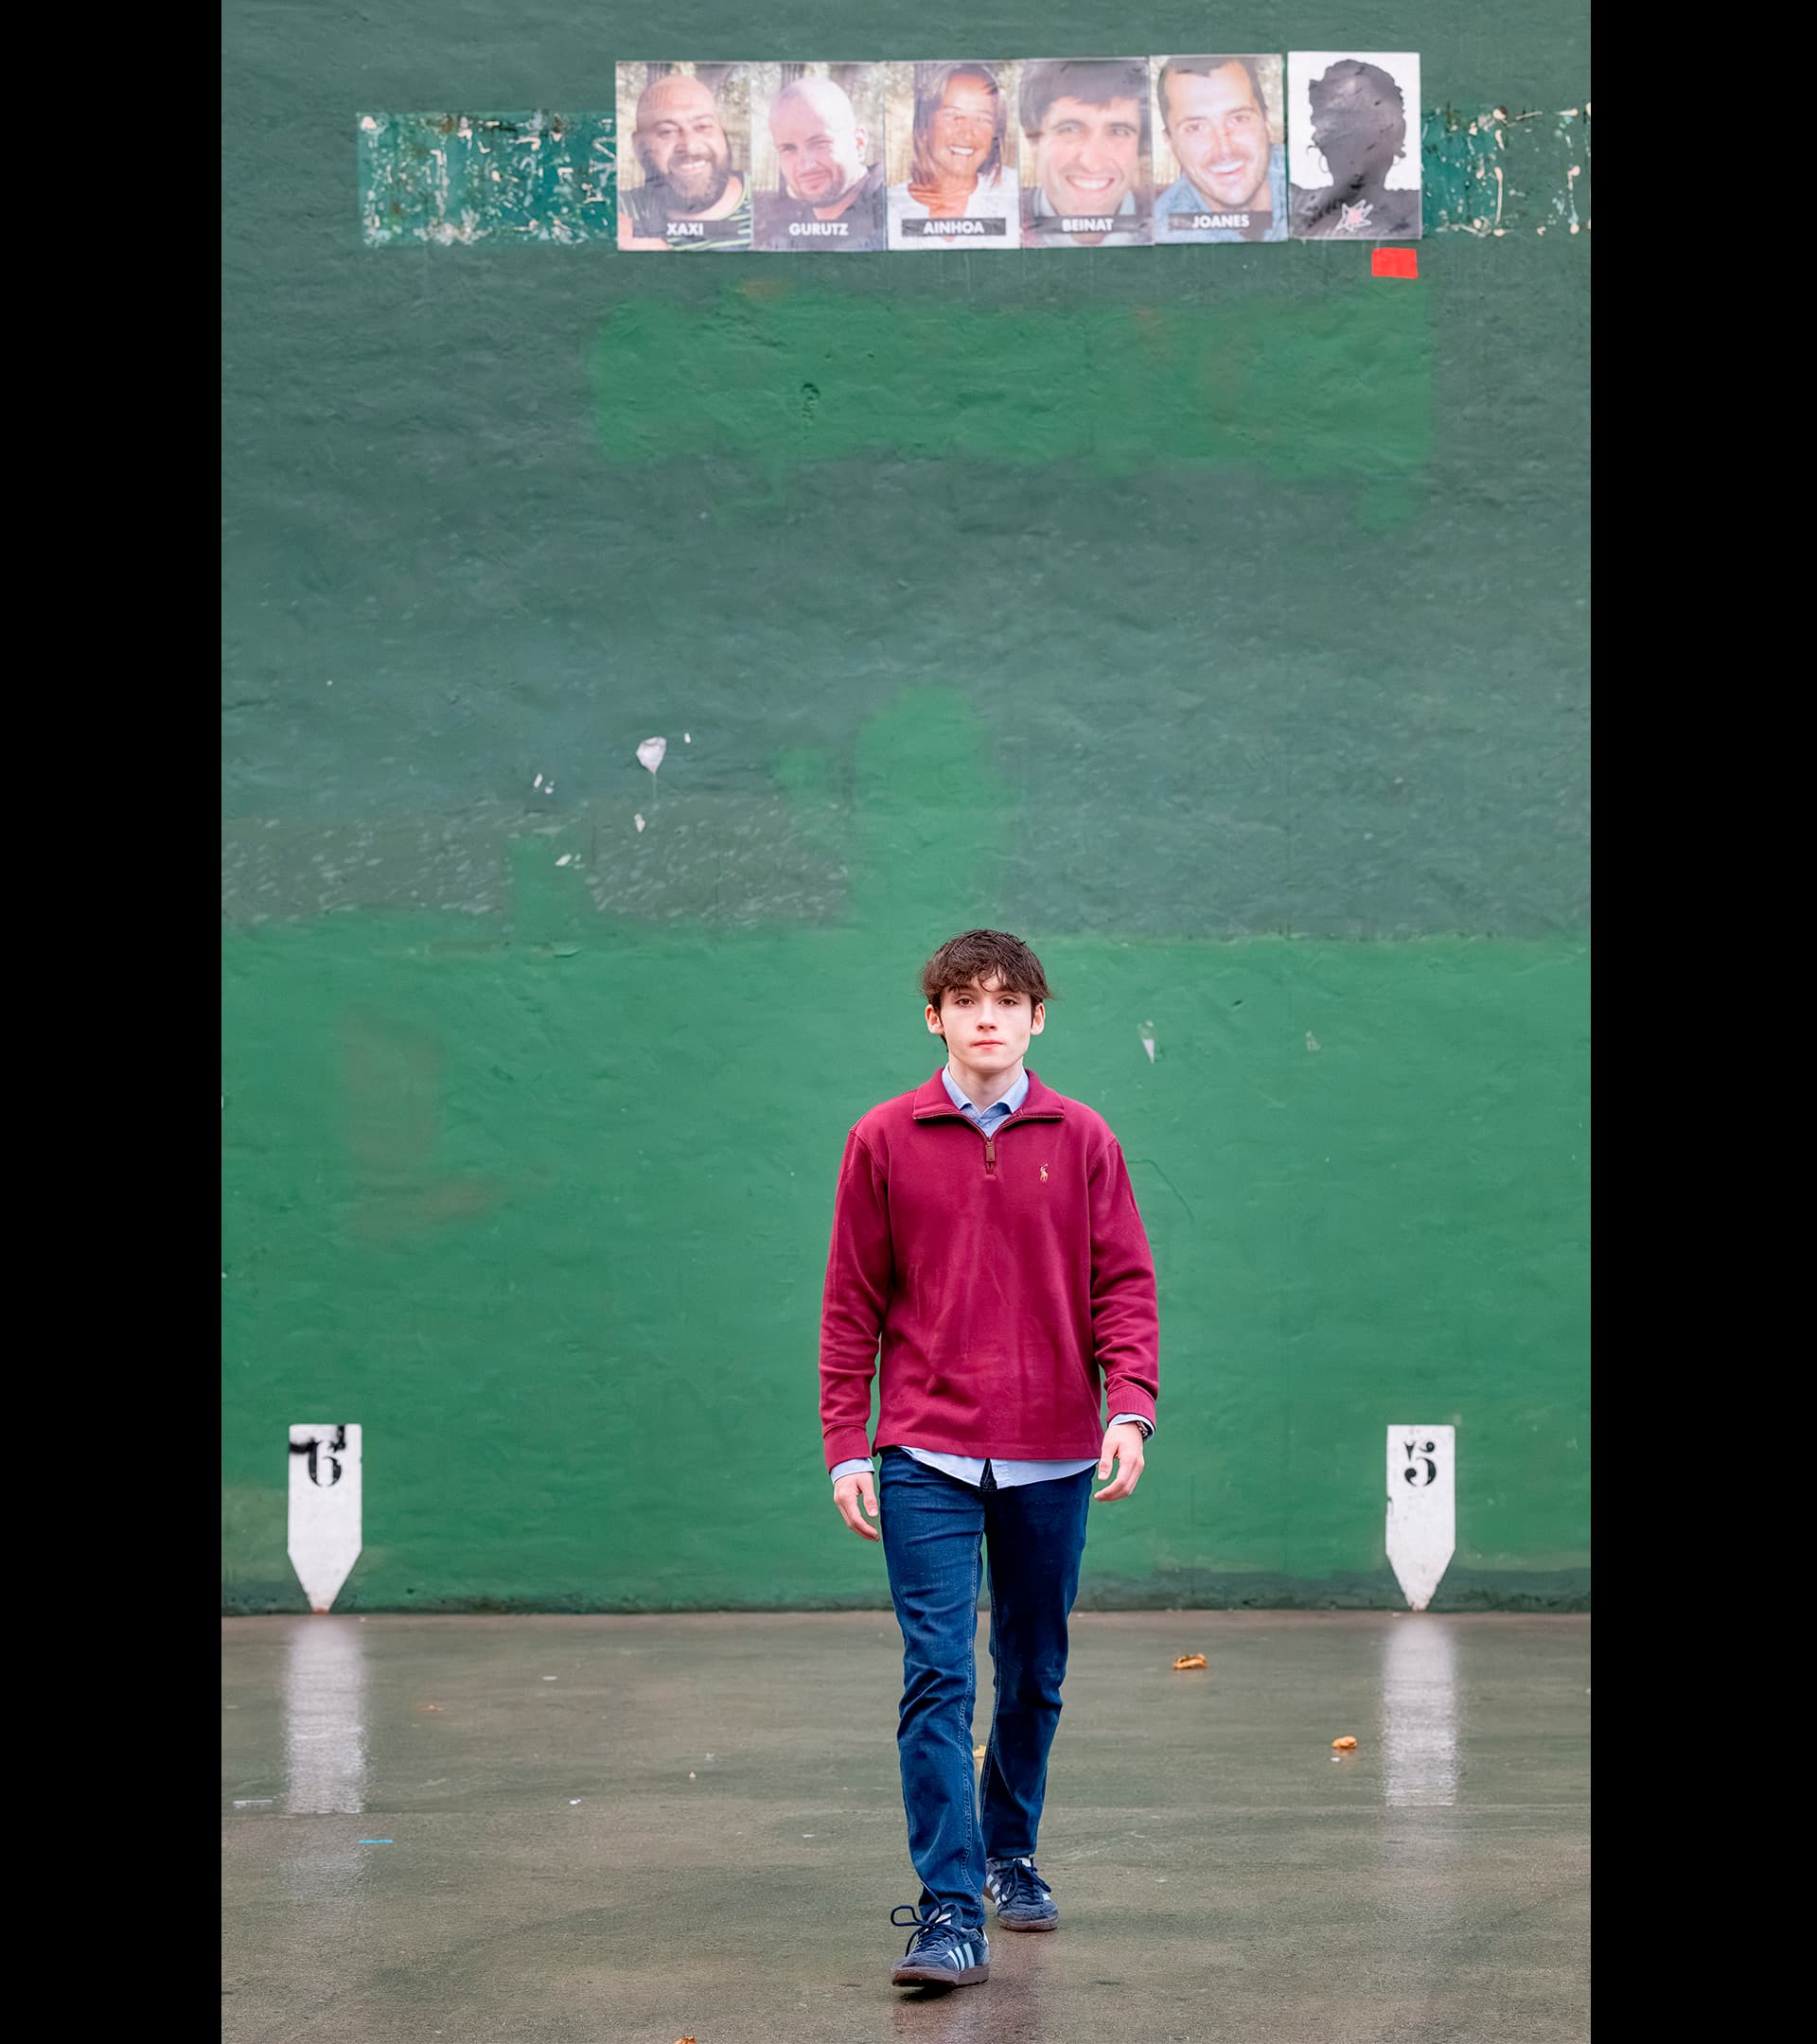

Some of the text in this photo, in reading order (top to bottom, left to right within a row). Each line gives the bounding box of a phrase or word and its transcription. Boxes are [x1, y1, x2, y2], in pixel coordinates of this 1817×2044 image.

[923, 221, 985, 236] AINHOA
[1062, 218, 1114, 233] BEINAT
[1191, 214, 1250, 229] JOANES
[666, 223, 704, 236] XAXI
[788, 222, 849, 237] GURUTZ
[309, 1439, 344, 1488] 6
[1404, 1440, 1437, 1487] 5
